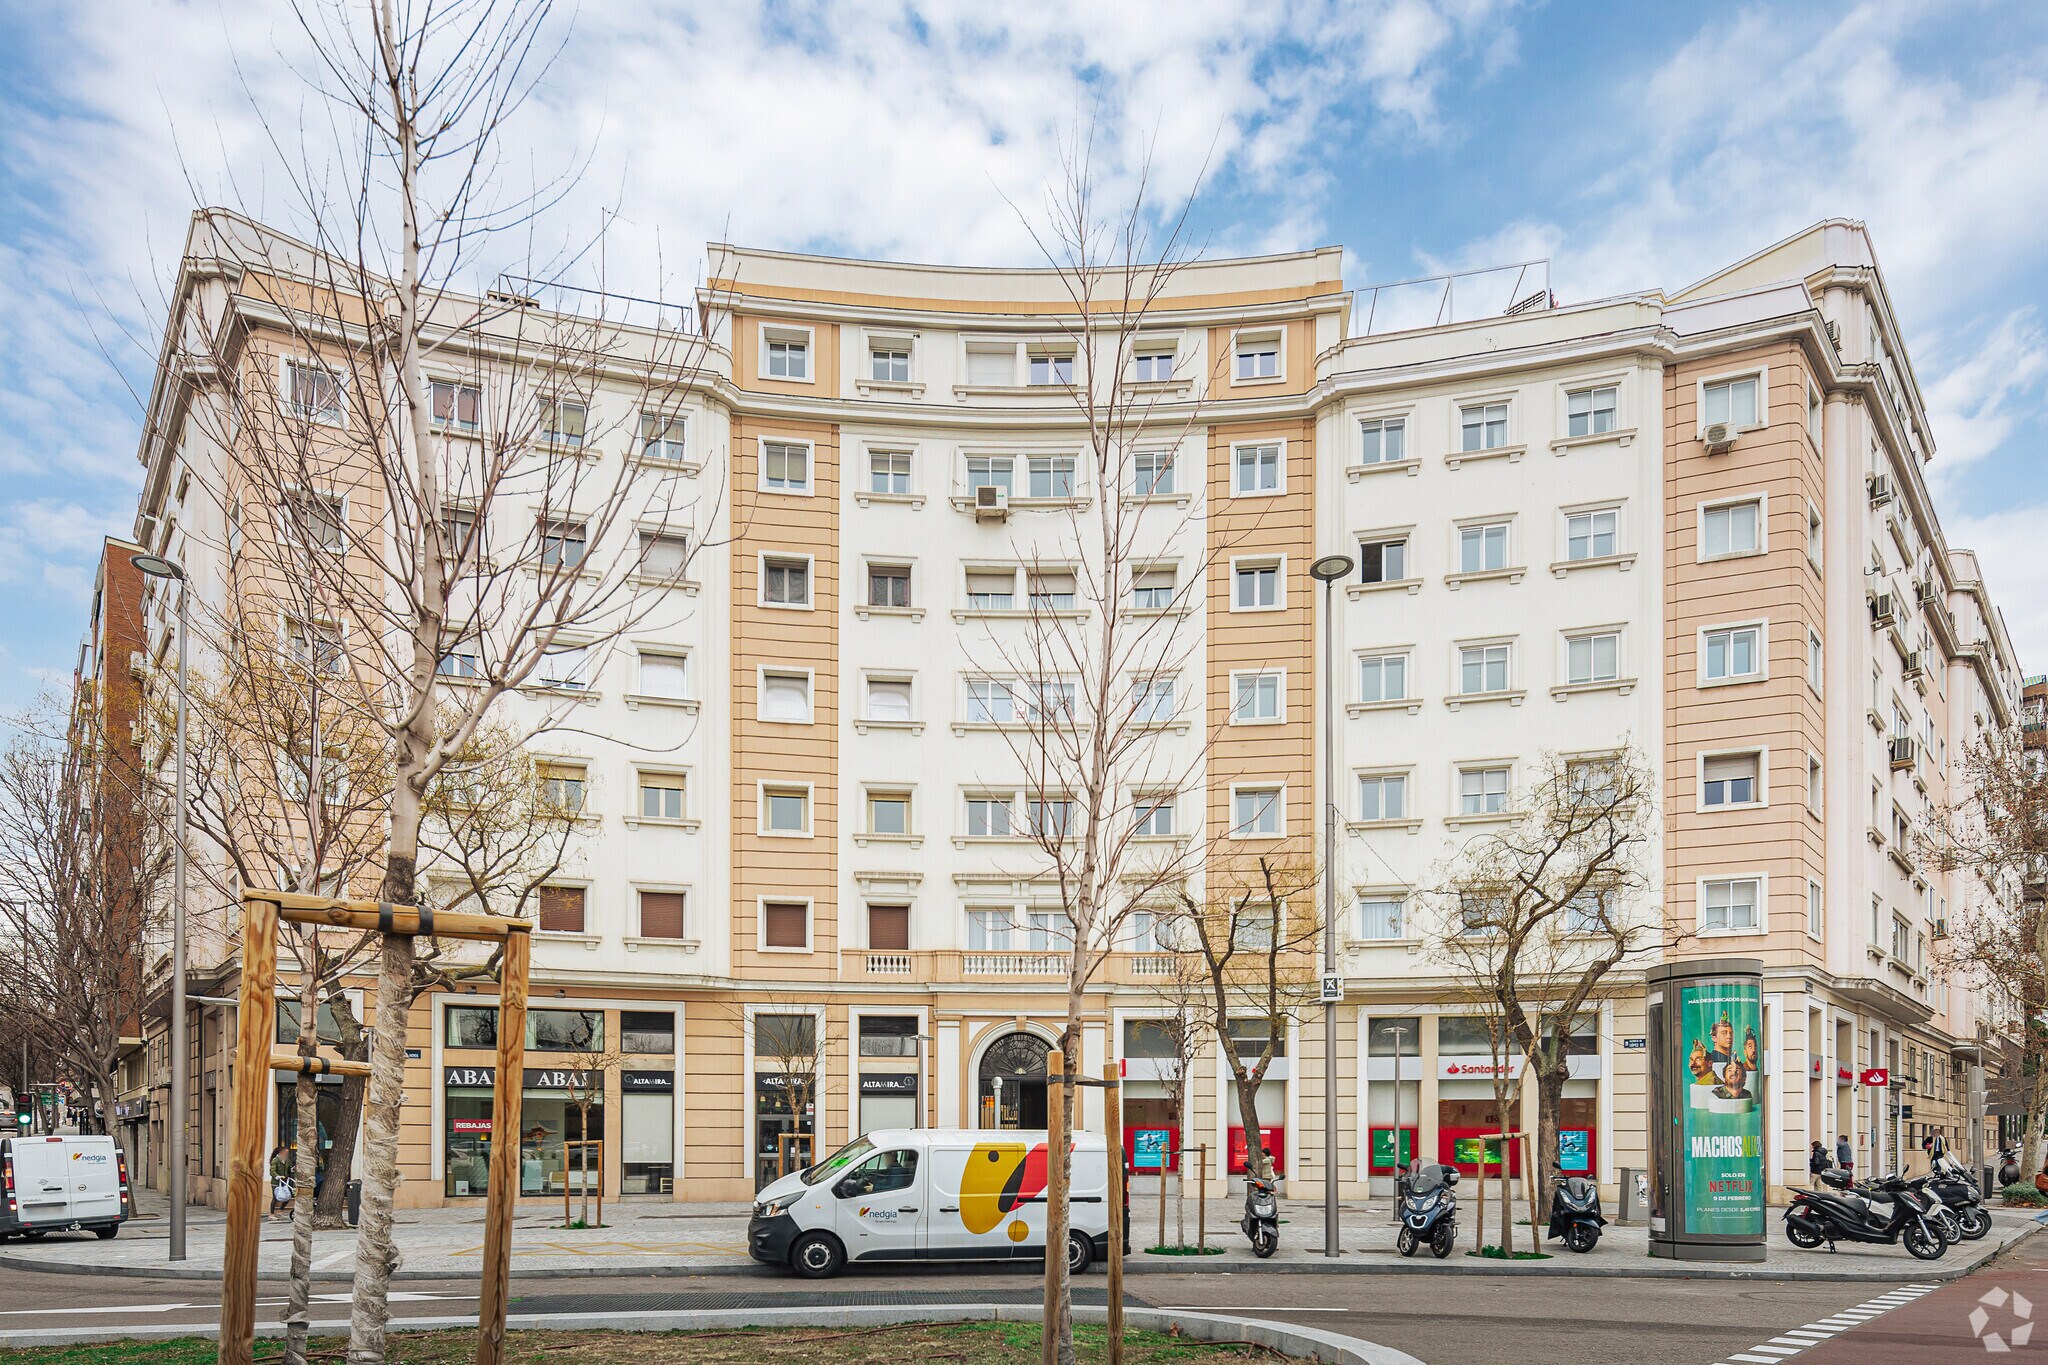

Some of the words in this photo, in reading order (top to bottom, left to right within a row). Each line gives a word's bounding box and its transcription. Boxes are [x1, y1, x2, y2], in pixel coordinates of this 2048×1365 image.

[81, 1154, 107, 1162] nedgia
[1709, 1180, 1753, 1193] NETFLIX
[869, 1210, 897, 1219] nedgia
